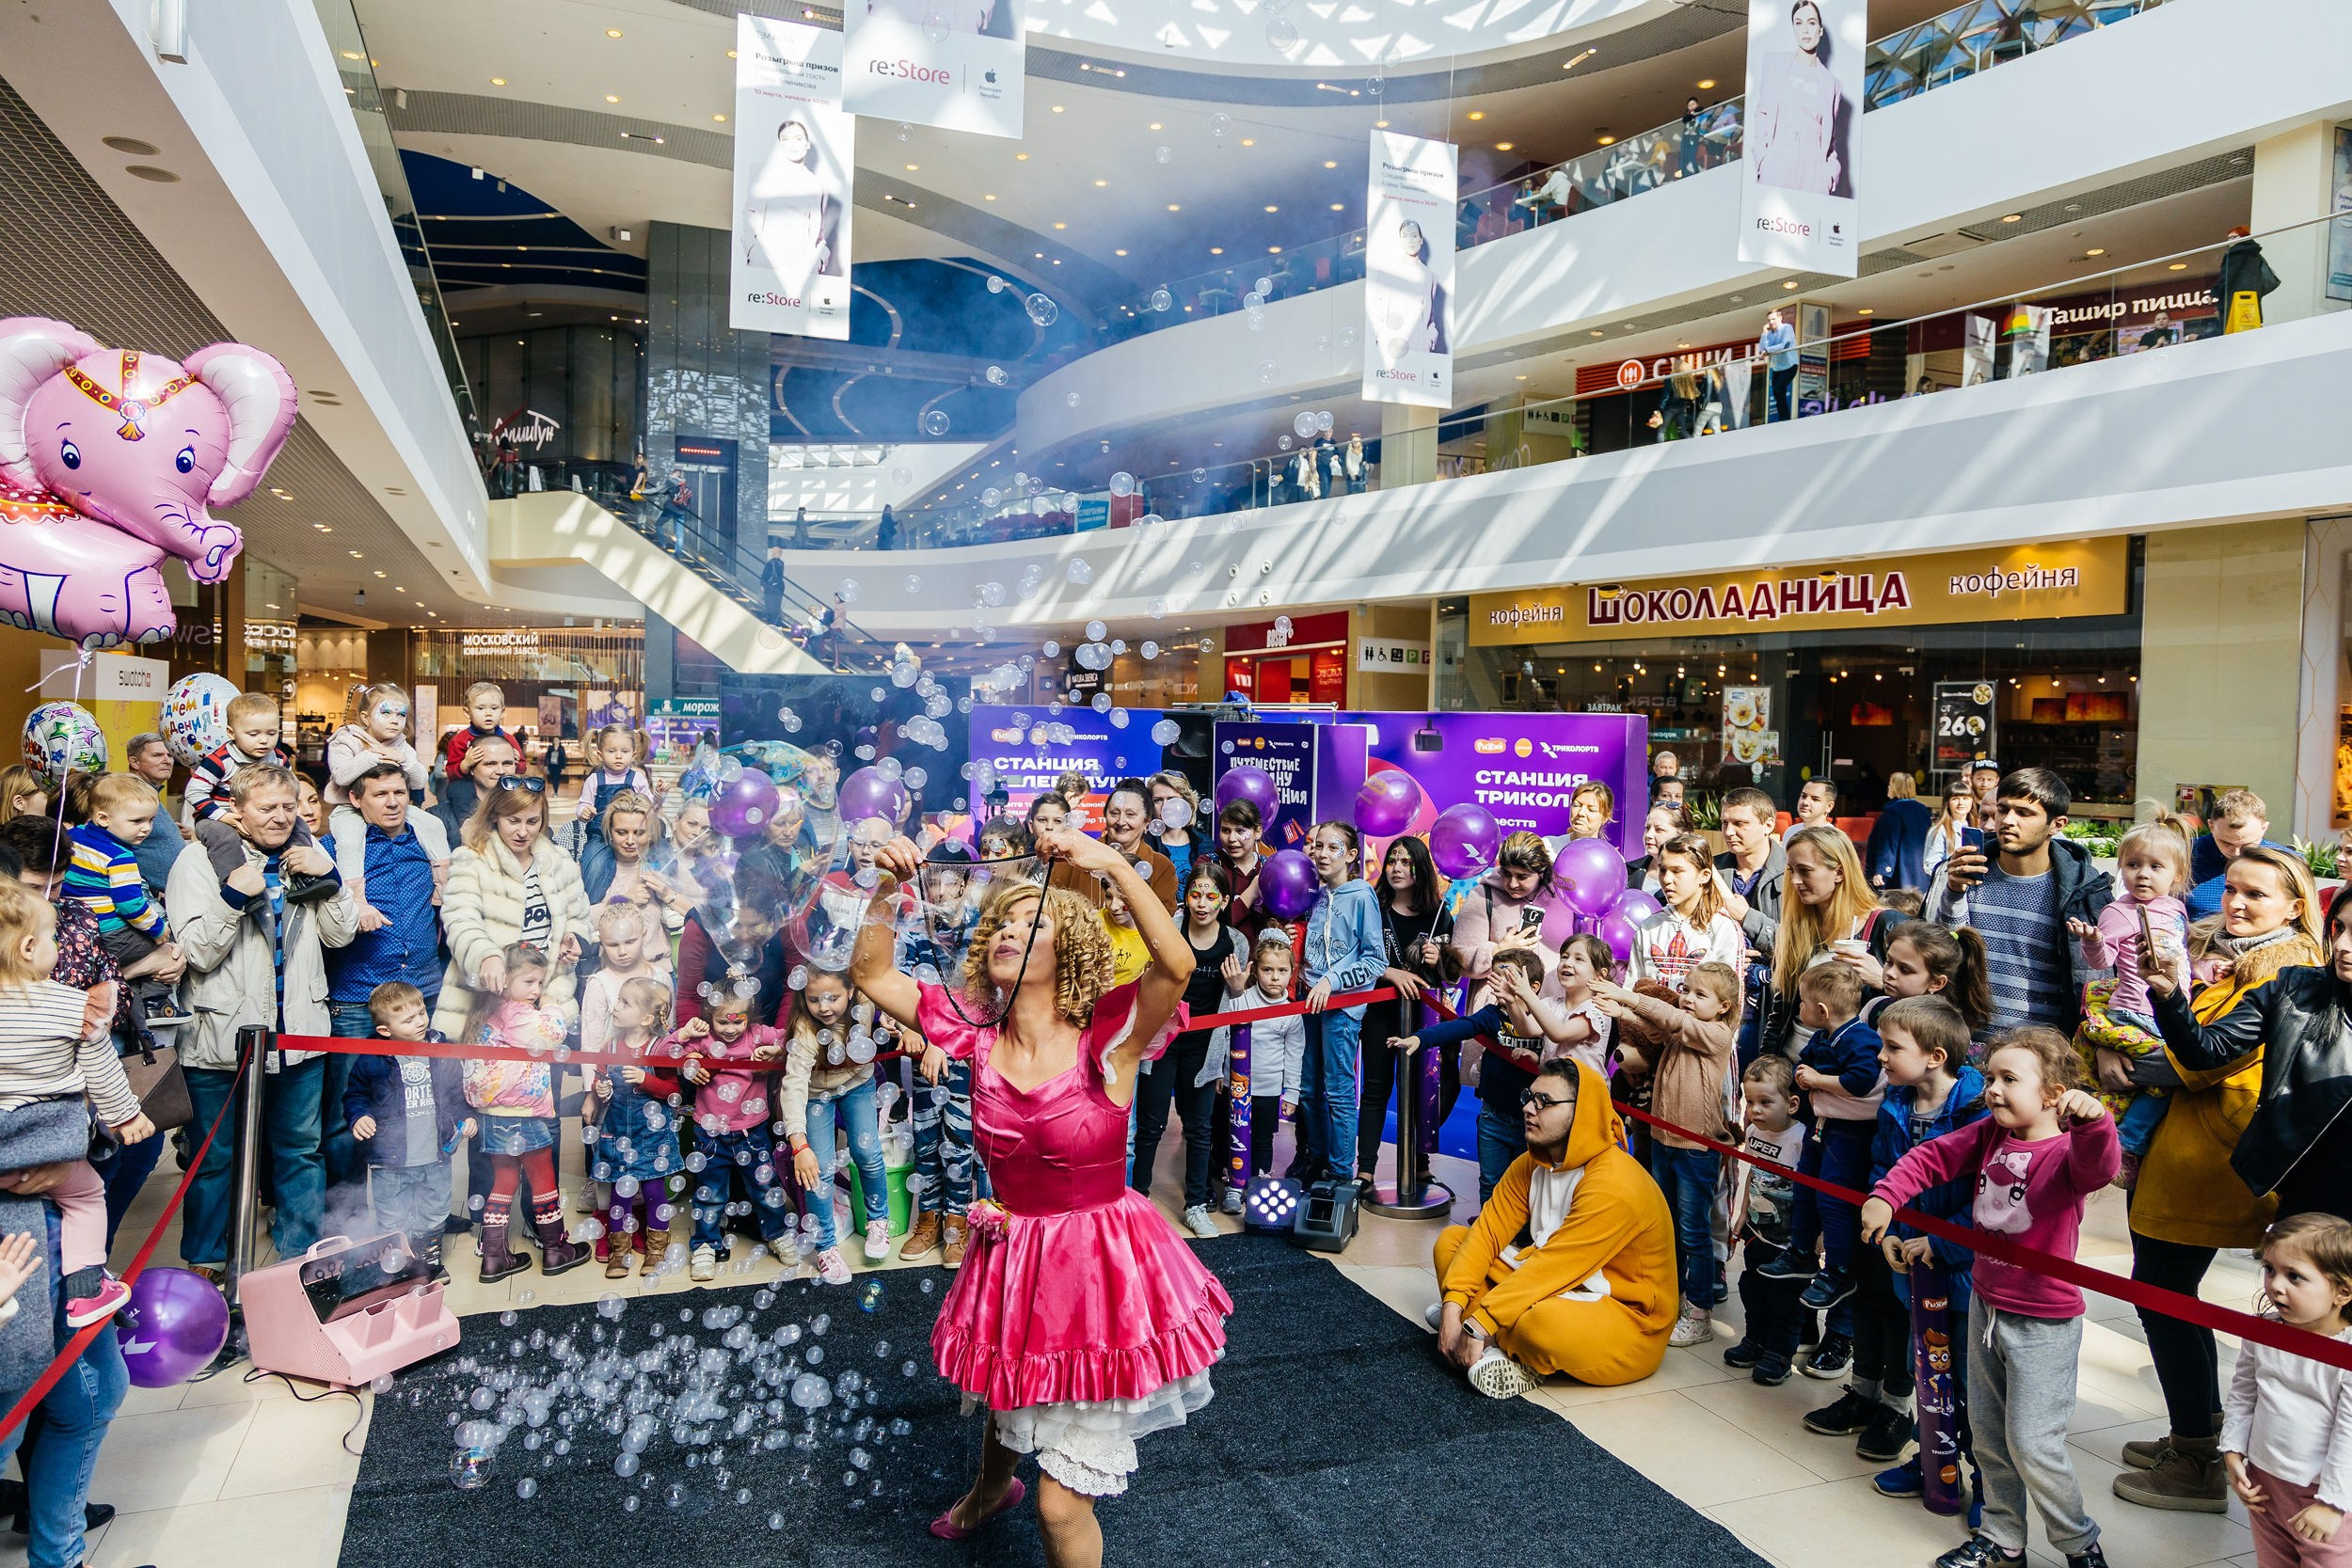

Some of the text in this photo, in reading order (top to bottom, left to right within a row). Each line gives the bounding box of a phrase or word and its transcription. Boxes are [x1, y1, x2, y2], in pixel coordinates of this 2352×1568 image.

[755, 52, 839, 73] Розыгрыш призов
[869, 59, 950, 85] re:Store
[1756, 217, 1810, 236] re:Store
[748, 292, 802, 308] re:Store
[2041, 289, 2219, 326] Ташир пицца
[1375, 368, 1417, 382] re:Store
[1948, 563, 2080, 597] кофейня
[1489, 602, 1565, 628] кофейня
[463, 631, 539, 646] МОСКОВСКИЙ
[463, 645, 539, 657] ЮВЕЛИРНЫЙ ЗАВОД
[1587, 704, 1622, 712] ЗАВТРАК
[993, 756, 1099, 771] СТАНЦИЯ
[1975, 759, 1998, 768] NASA
[1475, 769, 1589, 788] СТАНЦИЯ
